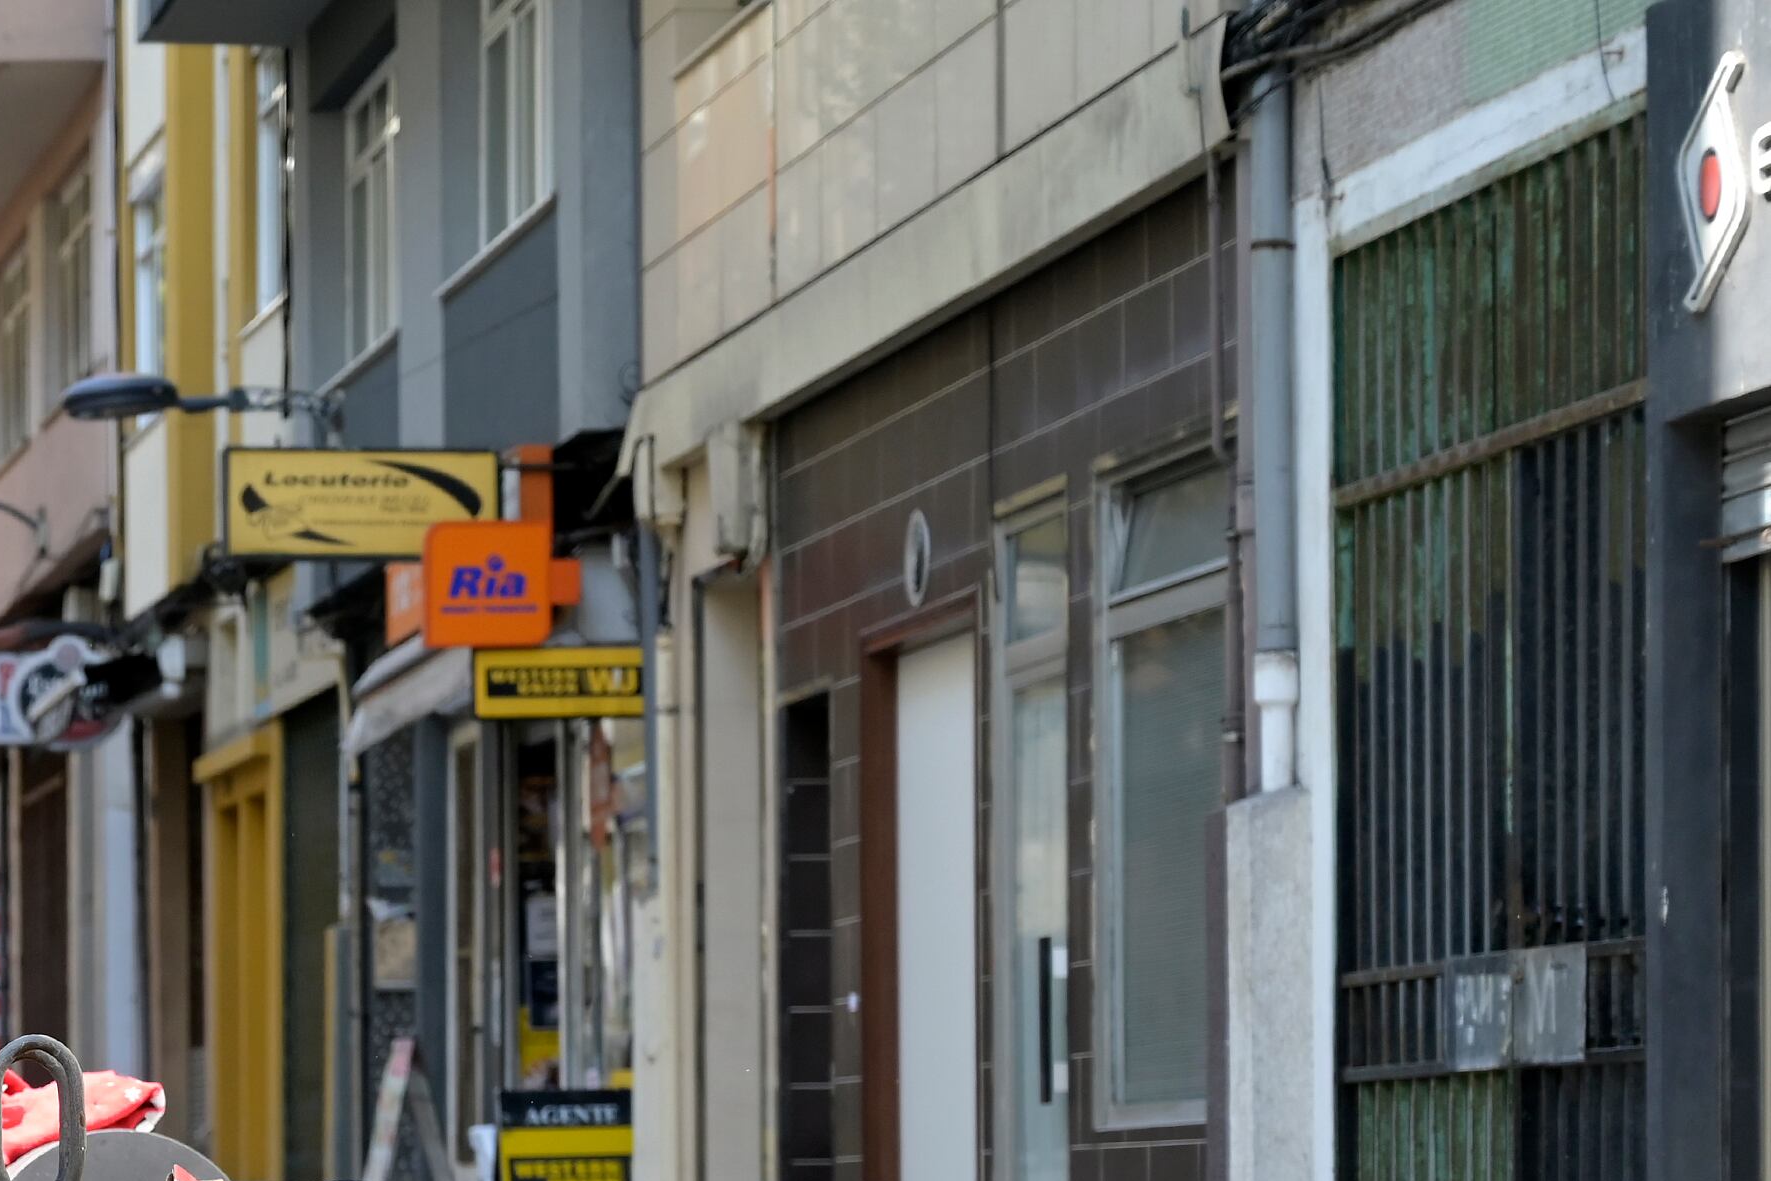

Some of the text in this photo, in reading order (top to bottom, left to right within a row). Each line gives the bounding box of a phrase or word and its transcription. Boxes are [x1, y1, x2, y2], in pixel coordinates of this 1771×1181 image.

[264, 471, 410, 488] Locutorio
[449, 554, 526, 599] Ria
[527, 1104, 618, 1124] AGENTE
